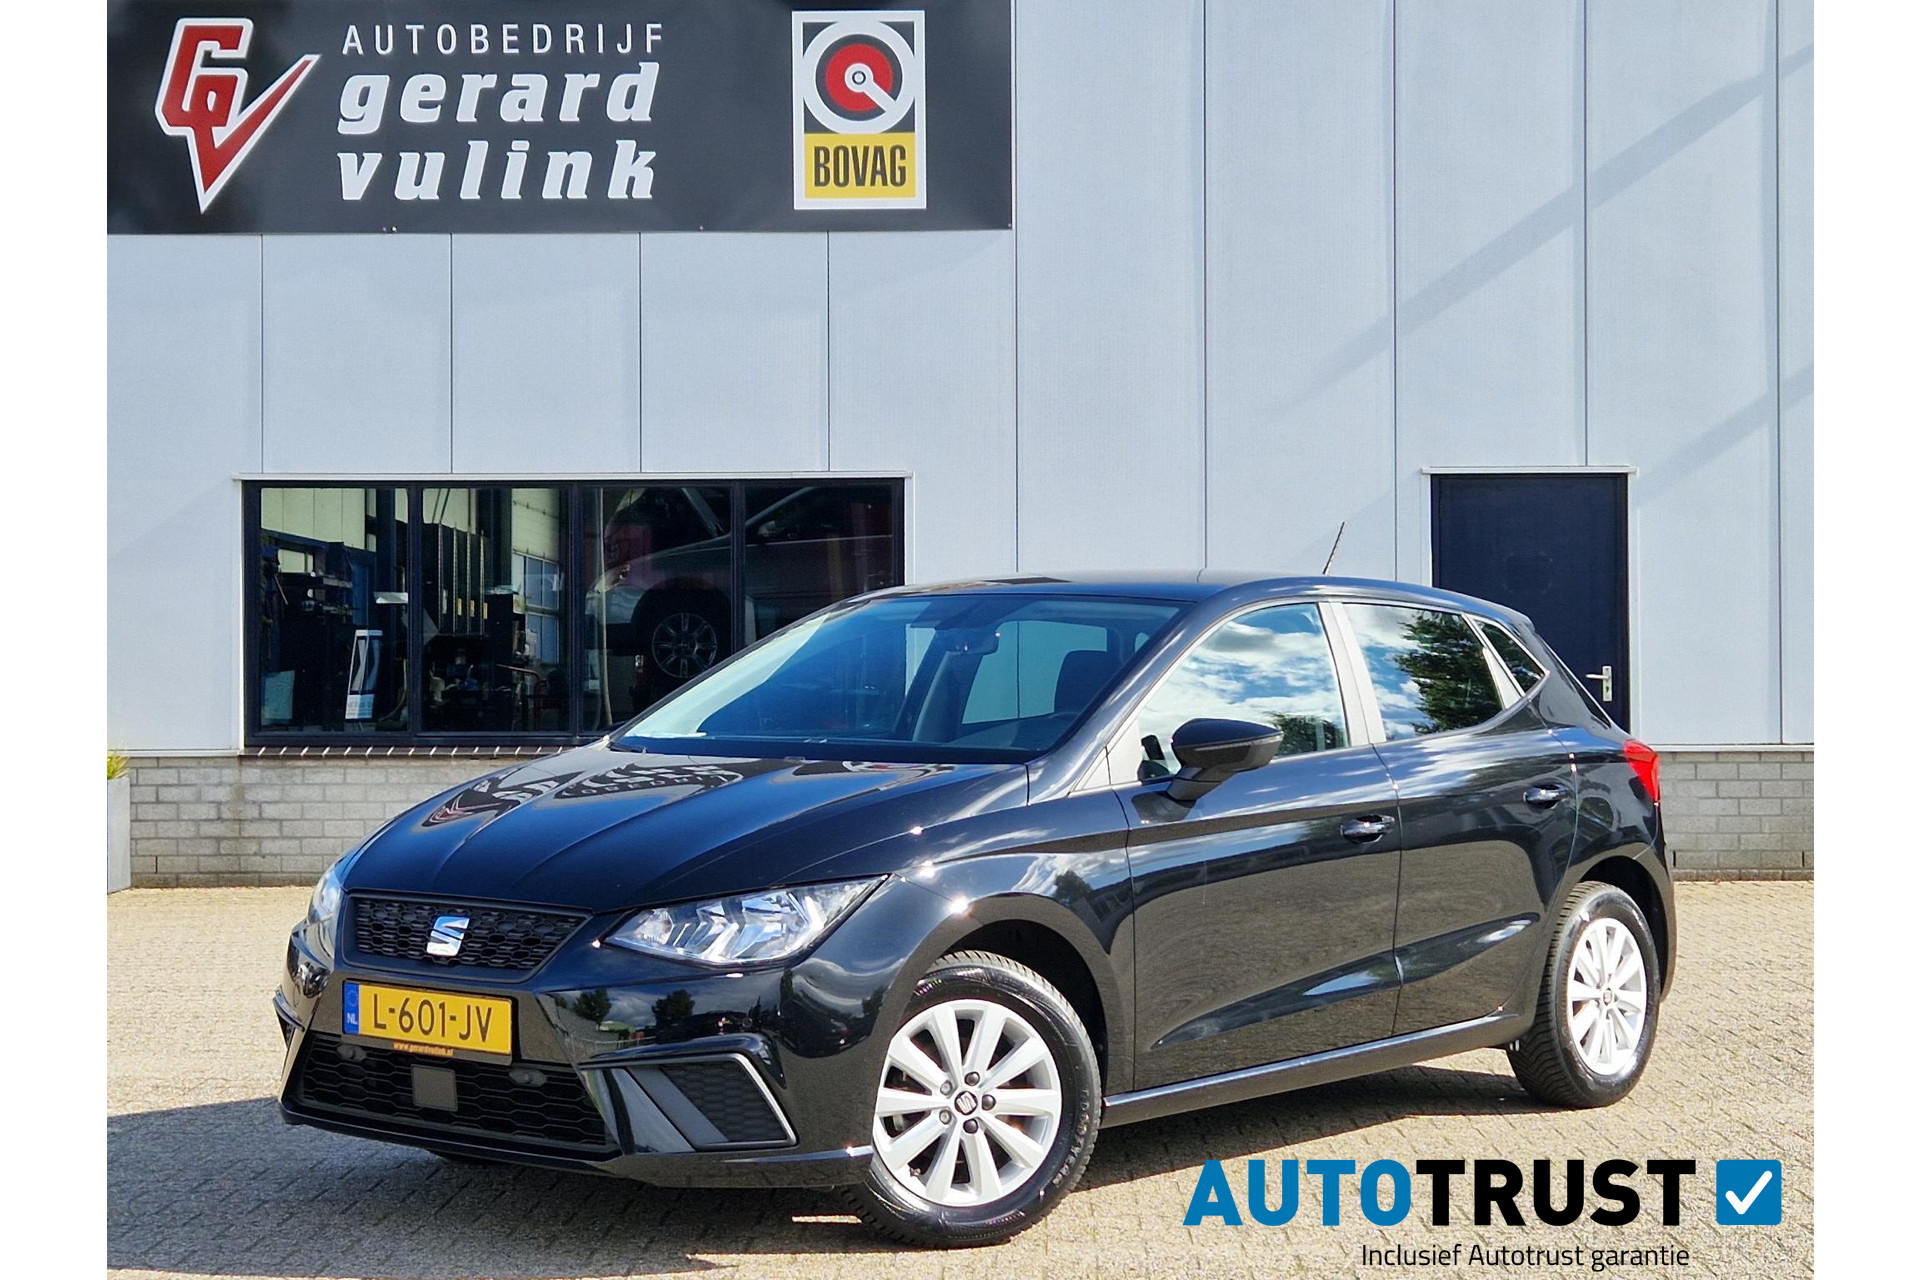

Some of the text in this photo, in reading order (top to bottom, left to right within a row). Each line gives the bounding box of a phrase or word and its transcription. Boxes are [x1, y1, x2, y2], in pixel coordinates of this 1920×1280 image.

[342, 23, 662, 55] AUTOBEDRIJF
[337, 61, 660, 135] gerard
[336, 139, 657, 201] vulink
[813, 144, 907, 188] BOVAG
[346, 1011, 358, 1025] NL
[373, 993, 493, 1042] L-601-JV
